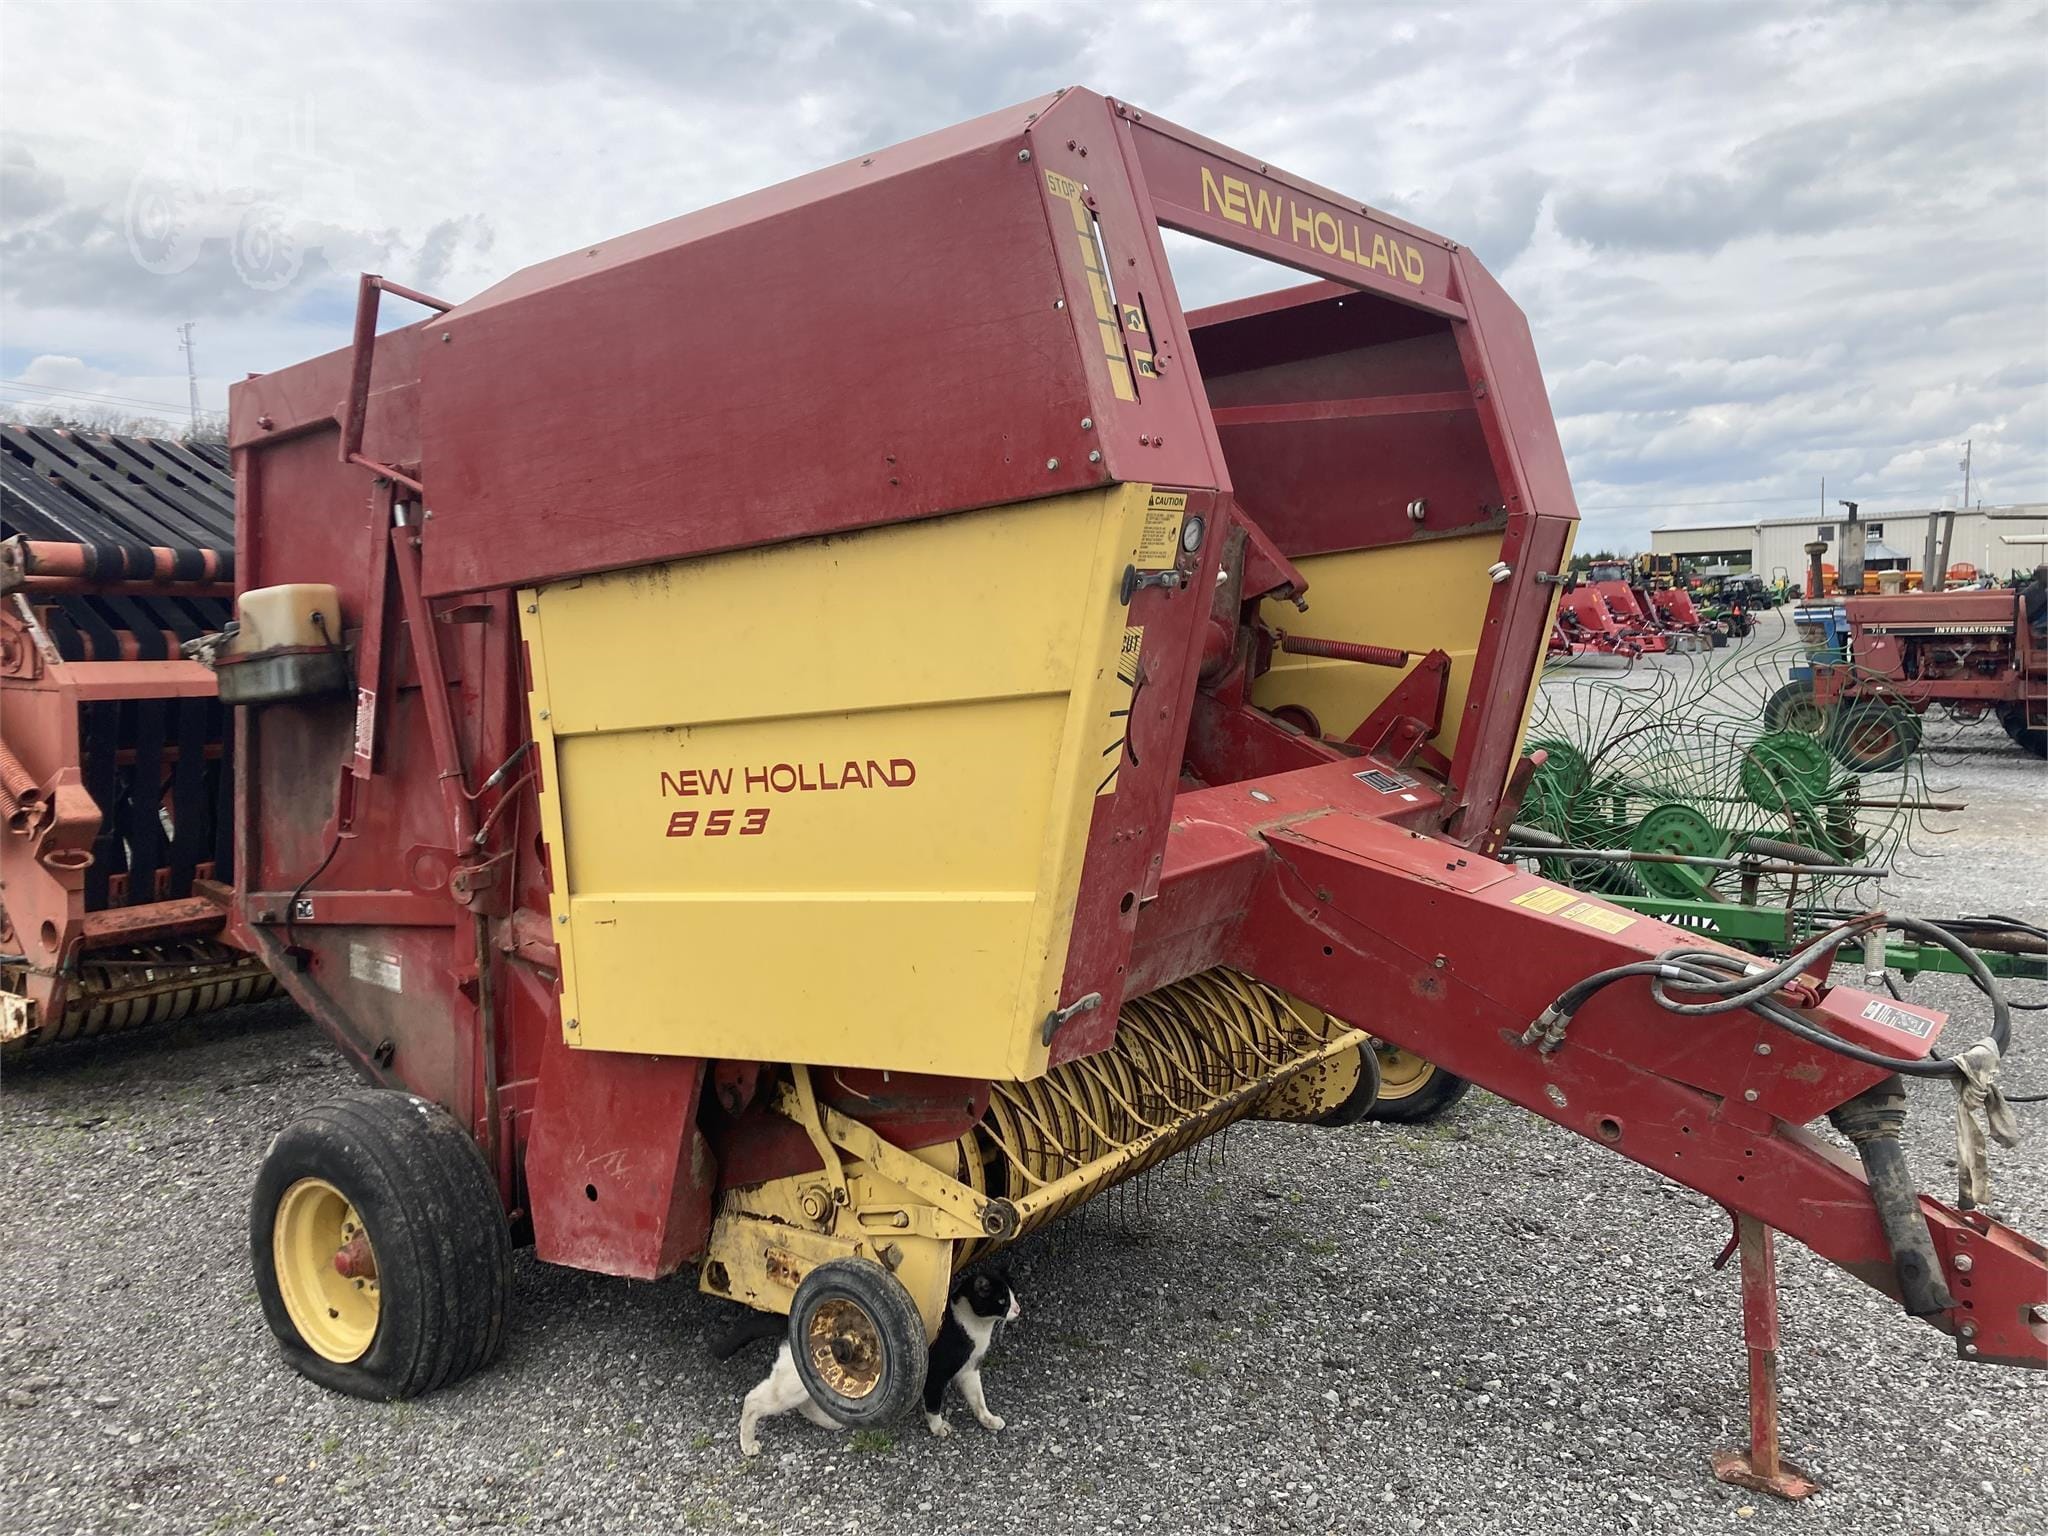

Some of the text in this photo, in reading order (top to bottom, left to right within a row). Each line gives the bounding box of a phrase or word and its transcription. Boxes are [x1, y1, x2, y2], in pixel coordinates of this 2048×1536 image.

[1047, 174, 1076, 198] STOP
[1201, 167, 1425, 286] NEW HOLLAND
[1155, 496, 1184, 506] CAUTION
[660, 758, 916, 797] NEW HOLLAND
[665, 808, 771, 838] 853
